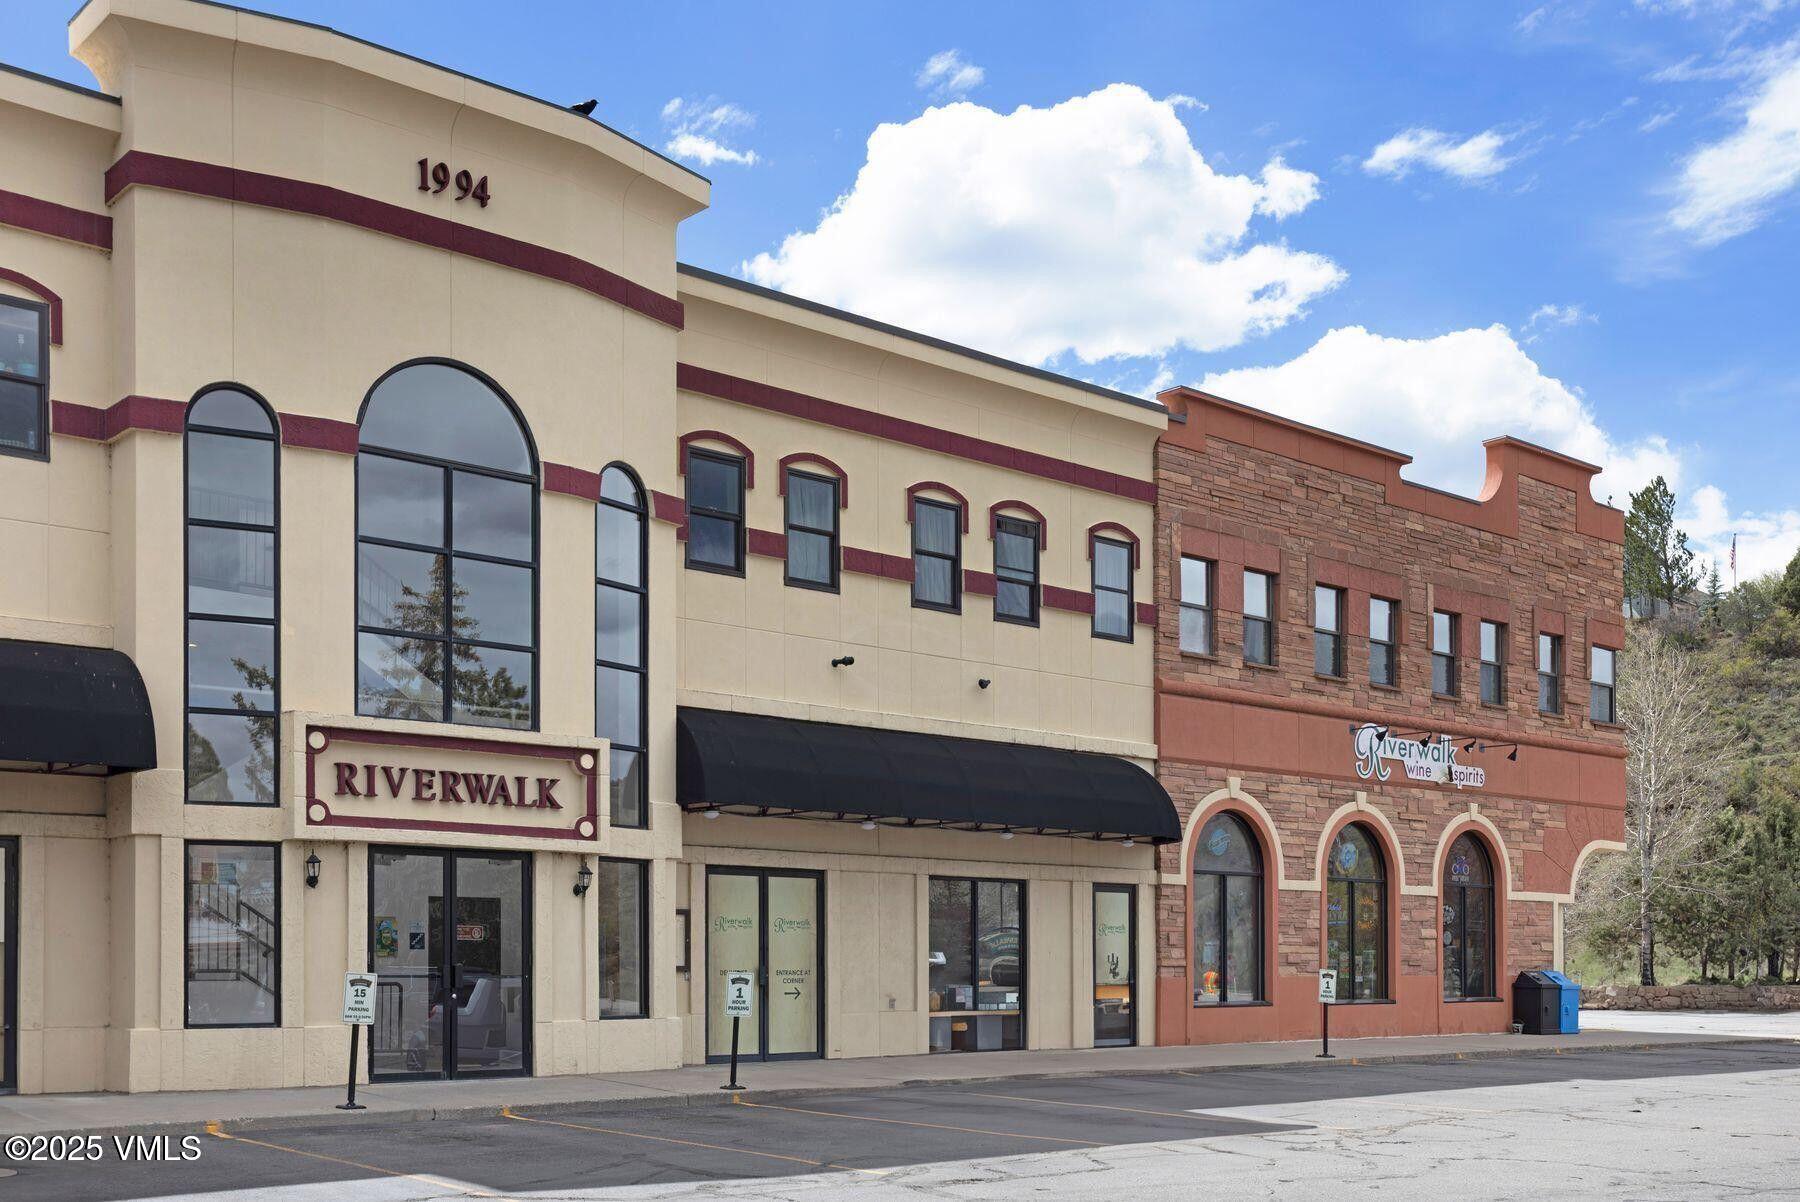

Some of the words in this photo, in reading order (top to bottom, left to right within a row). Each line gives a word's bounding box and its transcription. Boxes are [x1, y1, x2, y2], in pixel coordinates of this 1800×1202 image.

[418, 158, 491, 208] 1994
[1355, 723, 1456, 779] Riverwalk
[1406, 761, 1432, 778] wine
[1454, 767, 1484, 787] spirits
[334, 762, 564, 810] RIVERWALK
[714, 916, 753, 932] Riverwalk
[773, 917, 812, 933] Riverwalk
[736, 988, 743, 998] 1
[1326, 981, 1330, 989] 1
[354, 989, 366, 998] 15
